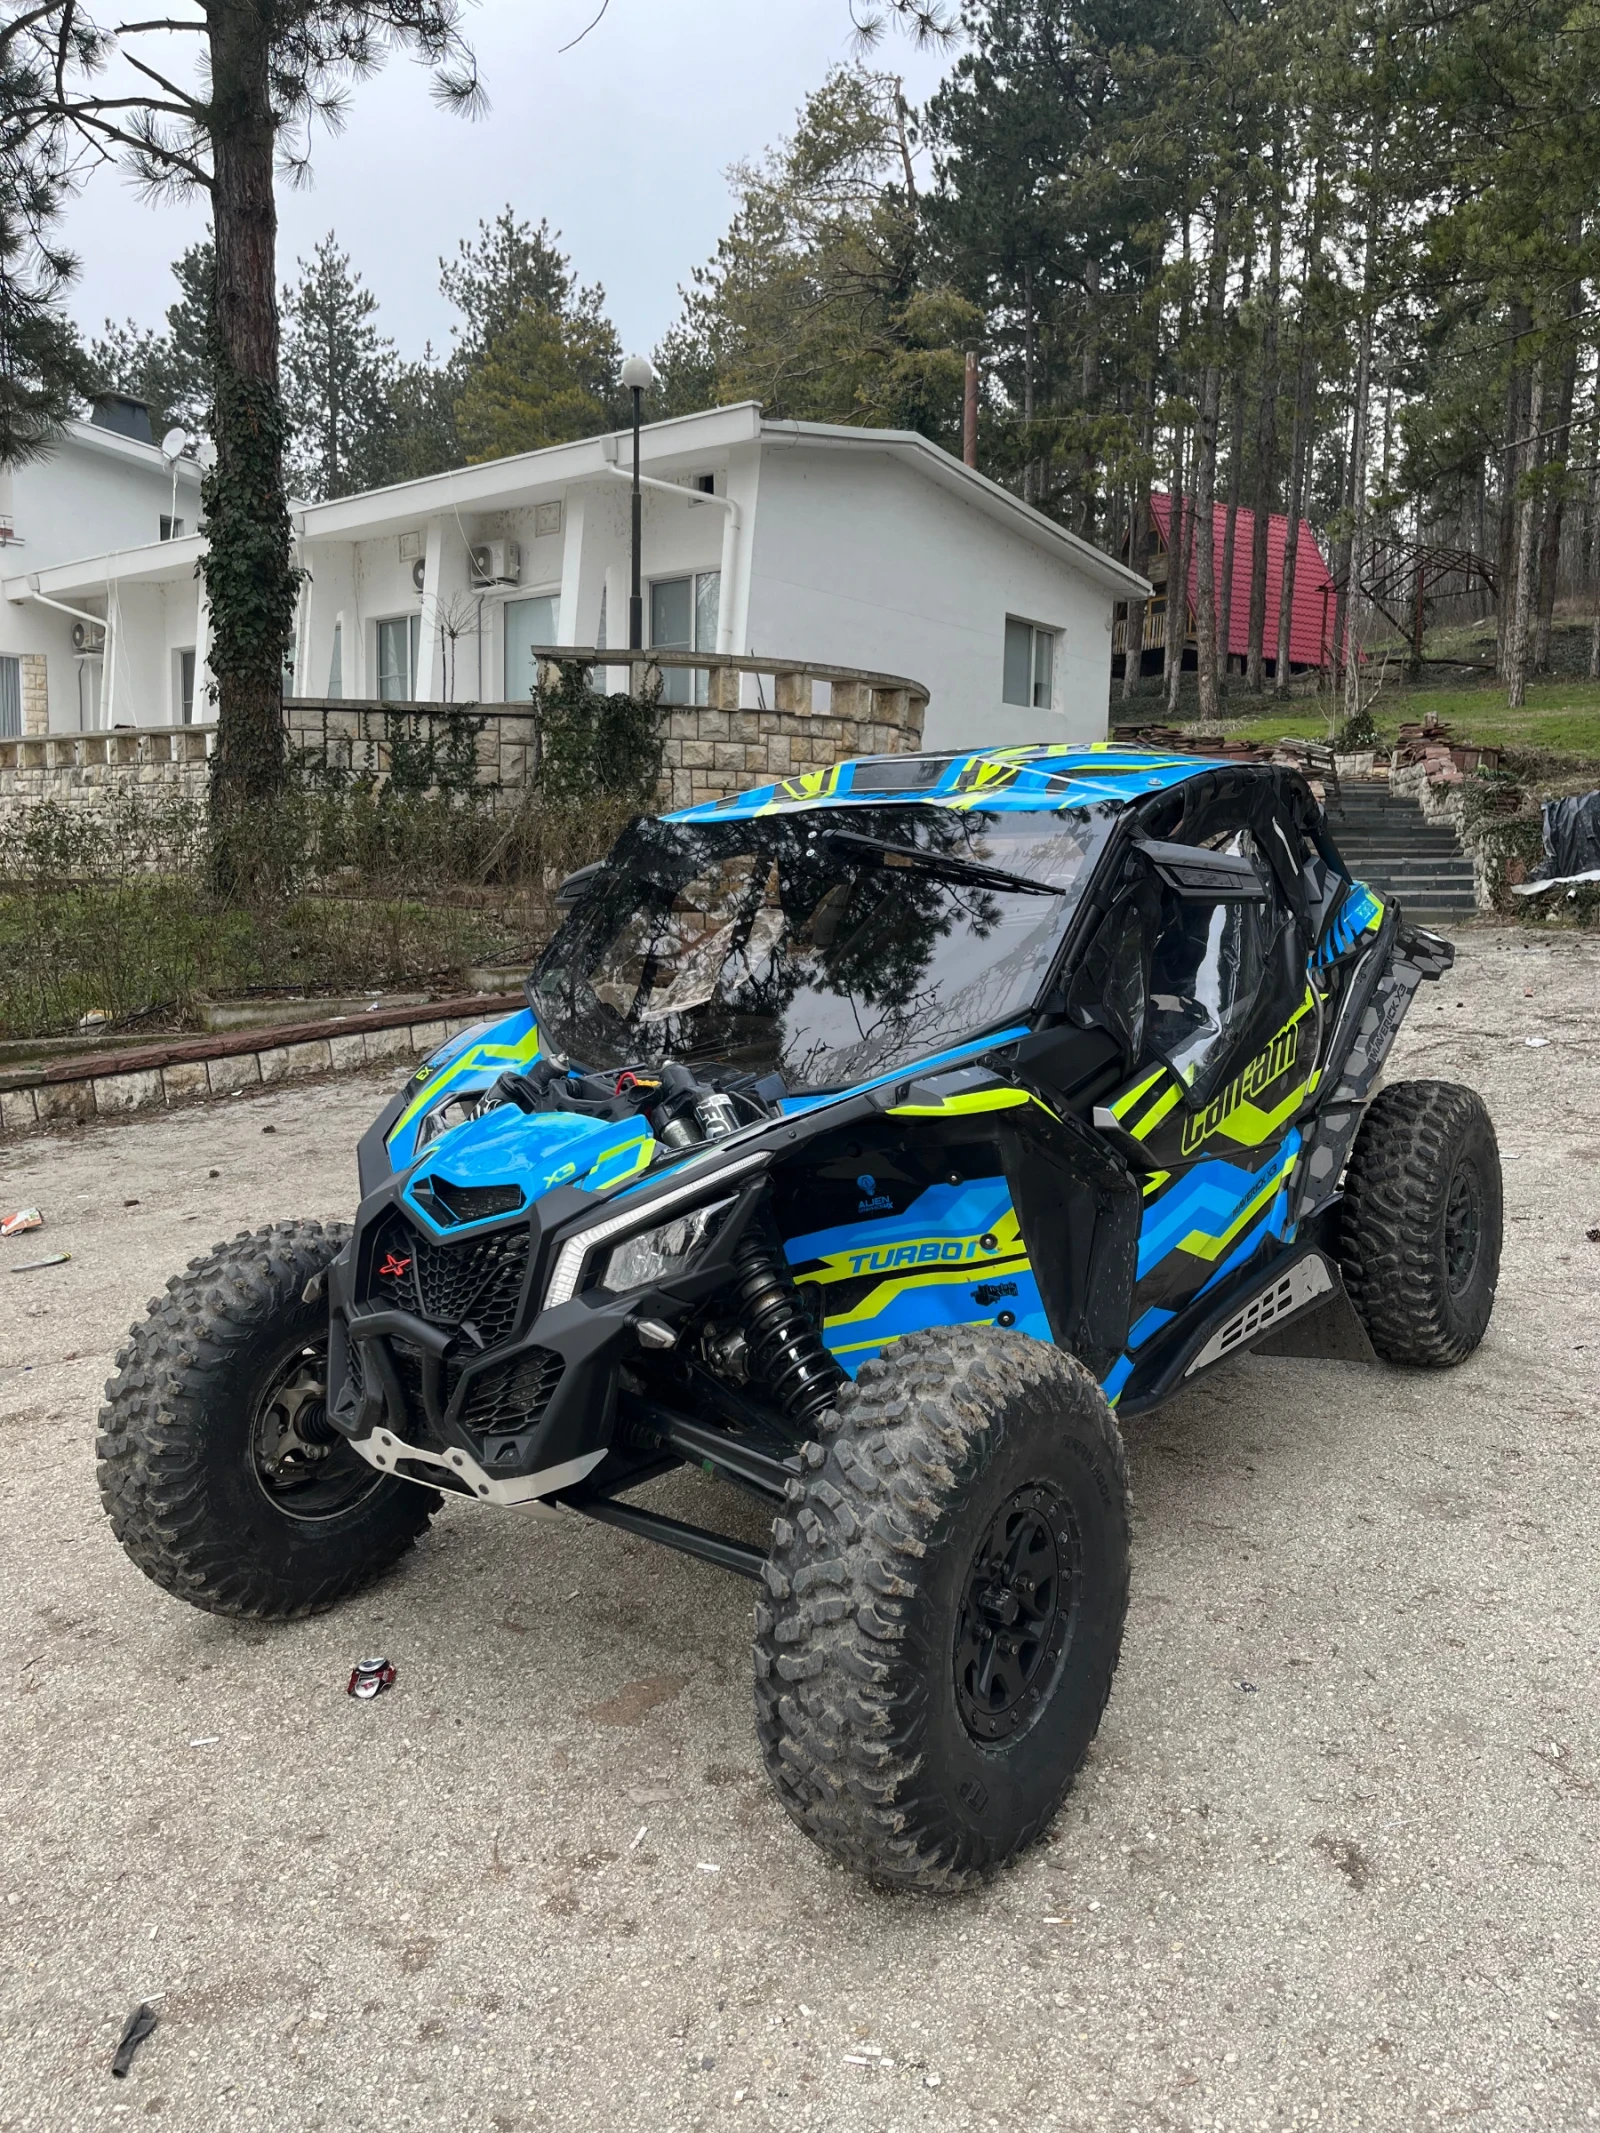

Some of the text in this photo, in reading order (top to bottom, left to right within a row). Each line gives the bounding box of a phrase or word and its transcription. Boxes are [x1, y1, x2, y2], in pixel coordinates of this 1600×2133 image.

[1367, 983, 1407, 1062] MAVERICK X3
[543, 1161, 576, 1190] X3
[1231, 1174, 1267, 1218] MAVERICK
[848, 1242, 964, 1274] TURBO
[1091, 1462, 1112, 1510] HOOK
